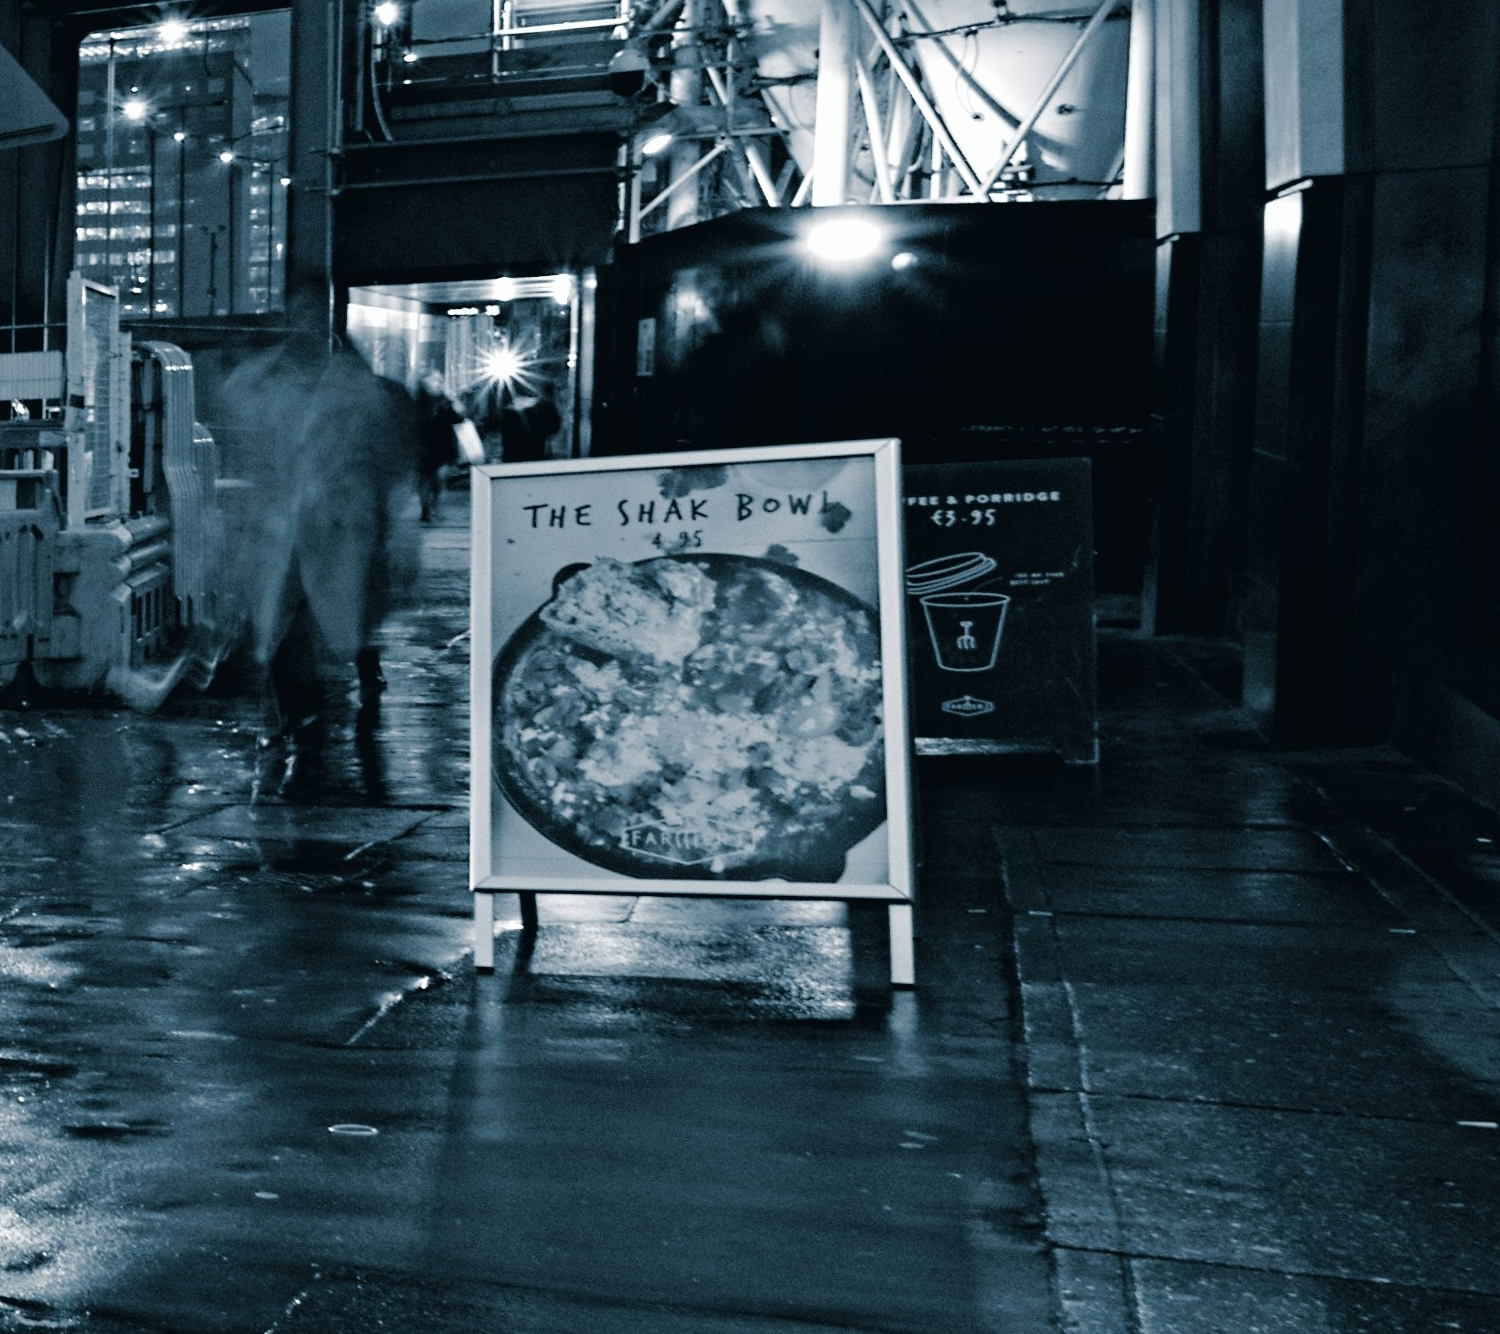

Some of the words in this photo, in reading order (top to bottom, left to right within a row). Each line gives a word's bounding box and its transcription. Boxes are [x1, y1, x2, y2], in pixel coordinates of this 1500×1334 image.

[902, 495, 940, 507] FEE
[946, 495, 959, 506] &
[964, 490, 1061, 505] PORRIDGE
[523, 504, 592, 528] THE
[617, 499, 709, 526] SHAK
